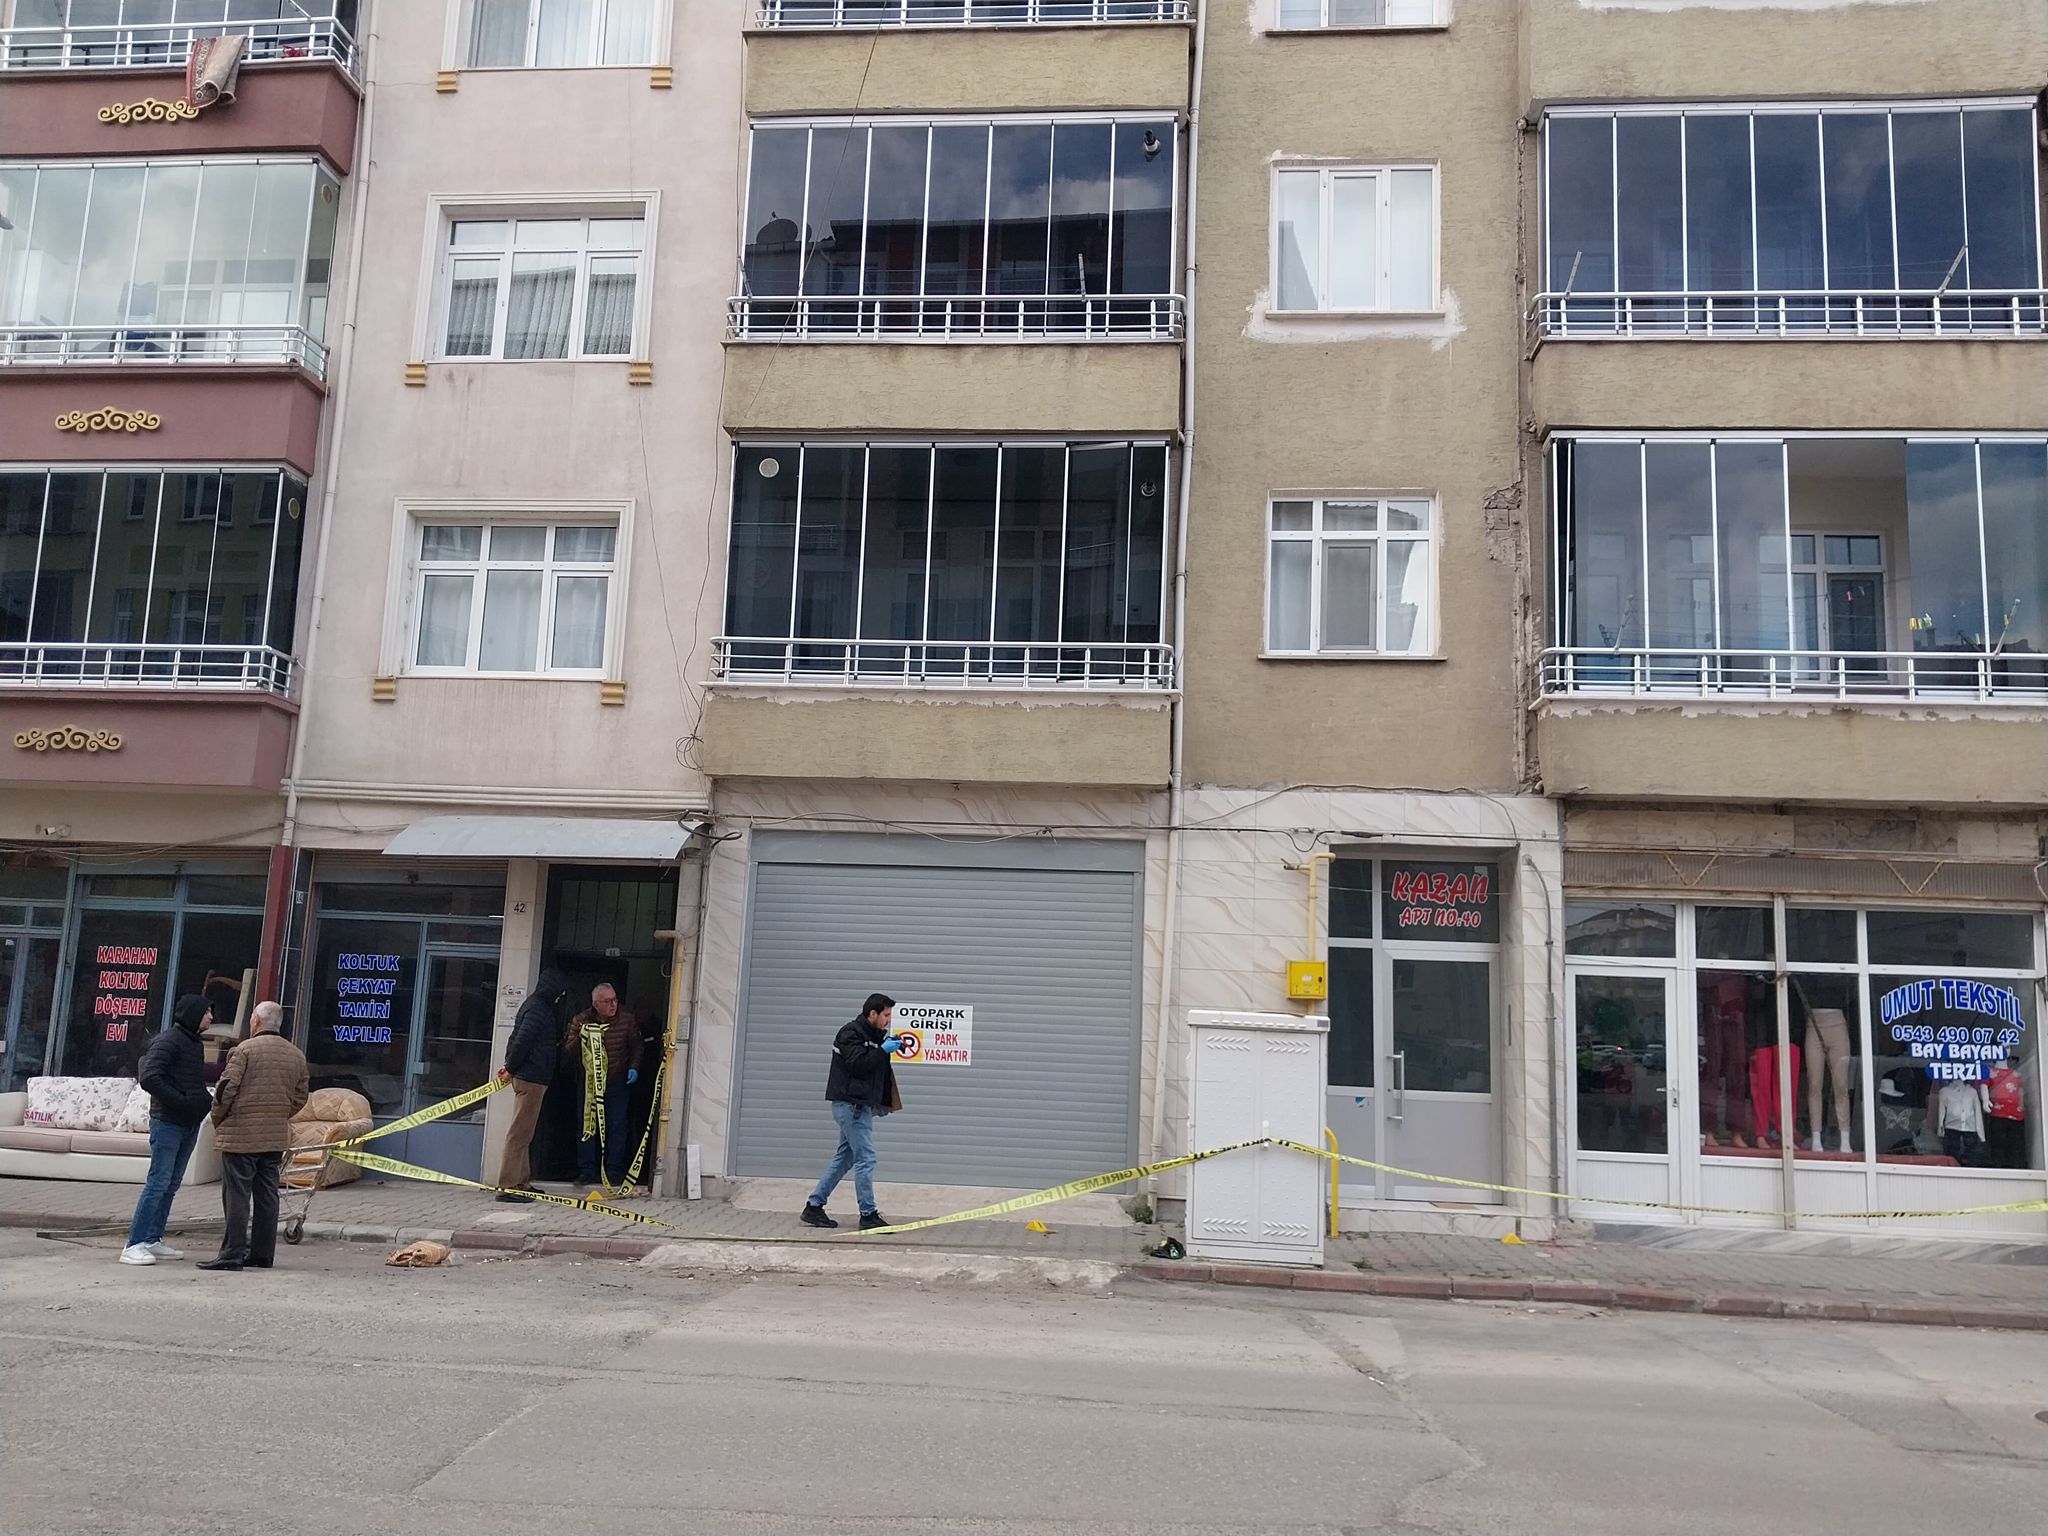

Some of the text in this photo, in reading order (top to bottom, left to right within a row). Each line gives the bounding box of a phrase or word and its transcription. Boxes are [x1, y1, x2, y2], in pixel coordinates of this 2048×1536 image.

[1391, 871, 1489, 906] KAZAN
[513, 903, 526, 913] 42
[1434, 908, 1482, 928] NO:40
[97, 946, 158, 965] KARAHAN
[338, 953, 401, 971] KOLTUK
[99, 971, 149, 990] KOLTUK
[338, 977, 397, 997] ÇEKYAT
[95, 993, 147, 1019] DÖŞEME
[338, 999, 391, 1018] TAMİRİ
[899, 1007, 966, 1019] OTOPARK
[1881, 979, 2025, 1031] UMUT TEKSTİL
[106, 1020, 128, 1041] EVİ
[333, 1025, 392, 1043] YAPILIR
[910, 1017, 954, 1032] GİRİŞİ
[934, 1033, 959, 1046] PARK
[1892, 1025, 2020, 1045] 0543 490 07 42
[924, 1049, 968, 1063] YASAKTIR
[1911, 1042, 2004, 1060] BAY BAYAN
[1929, 1060, 1982, 1081] TERZİ
[24, 1110, 54, 1122] SATILIK
